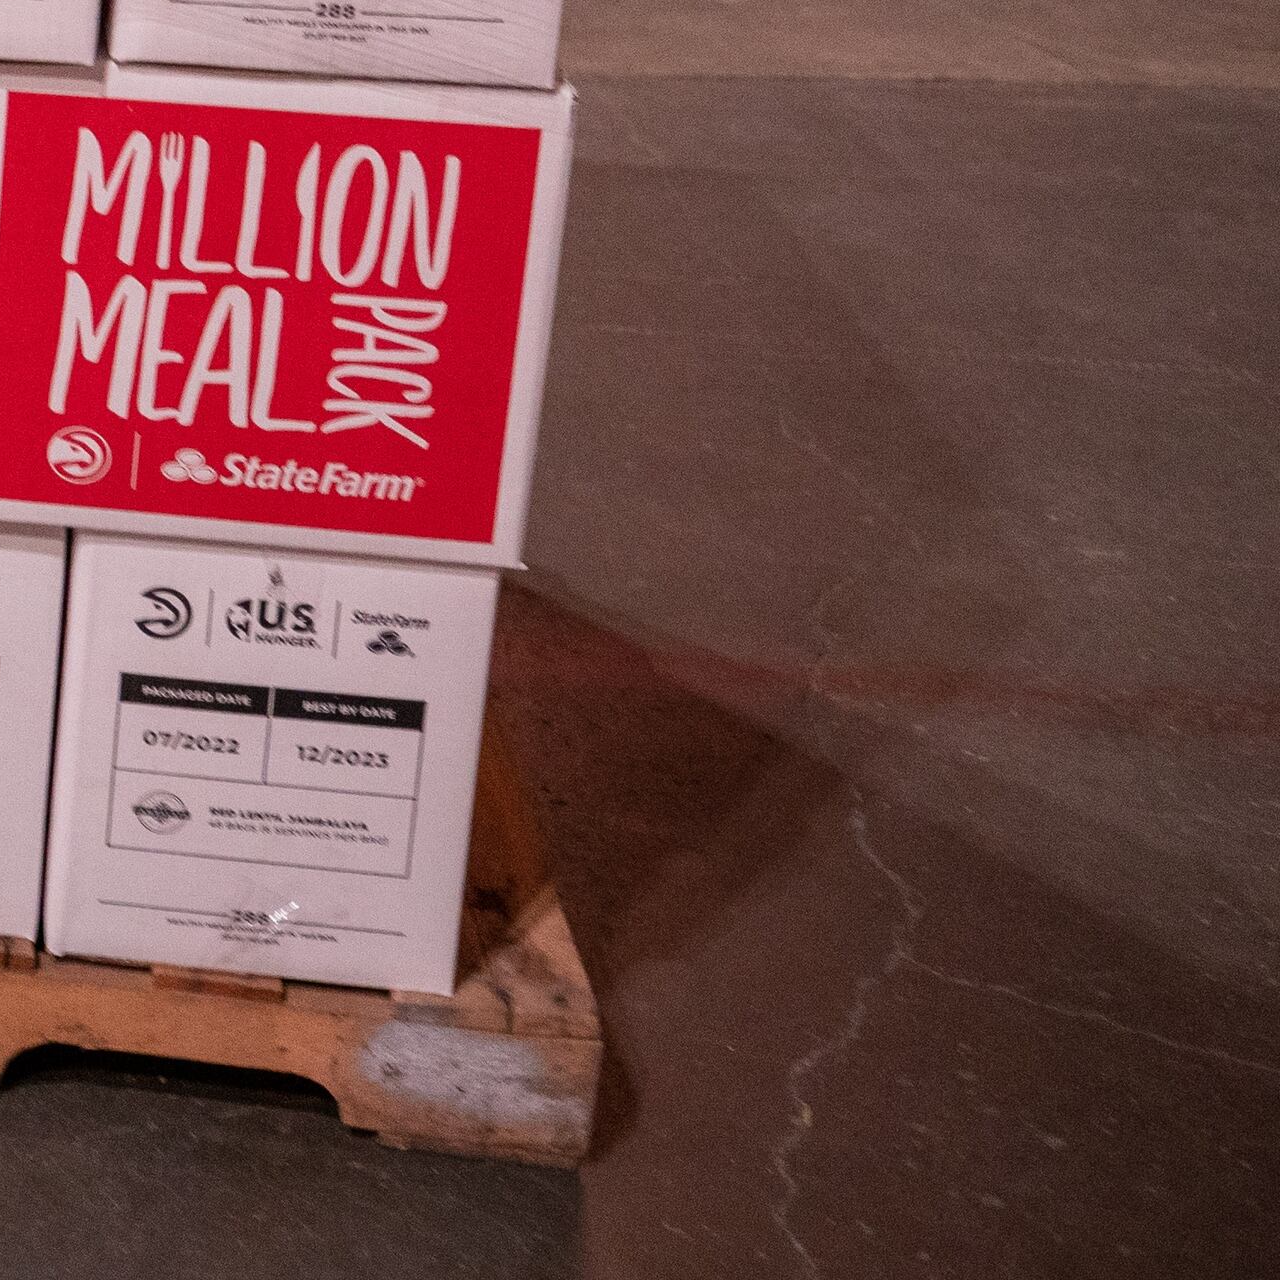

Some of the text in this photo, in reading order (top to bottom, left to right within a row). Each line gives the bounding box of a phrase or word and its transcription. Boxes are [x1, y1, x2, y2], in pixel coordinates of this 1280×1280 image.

[314, 1, 356, 20] 288
[59, 125, 462, 292] MILLION
[47, 269, 319, 435] MEAL
[319, 292, 449, 452] PACK
[216, 692, 252, 707] DATE
[302, 700, 397, 721] BEST BY DATE
[142, 727, 241, 756] 07/2022
[295, 742, 390, 771] 12/2023
